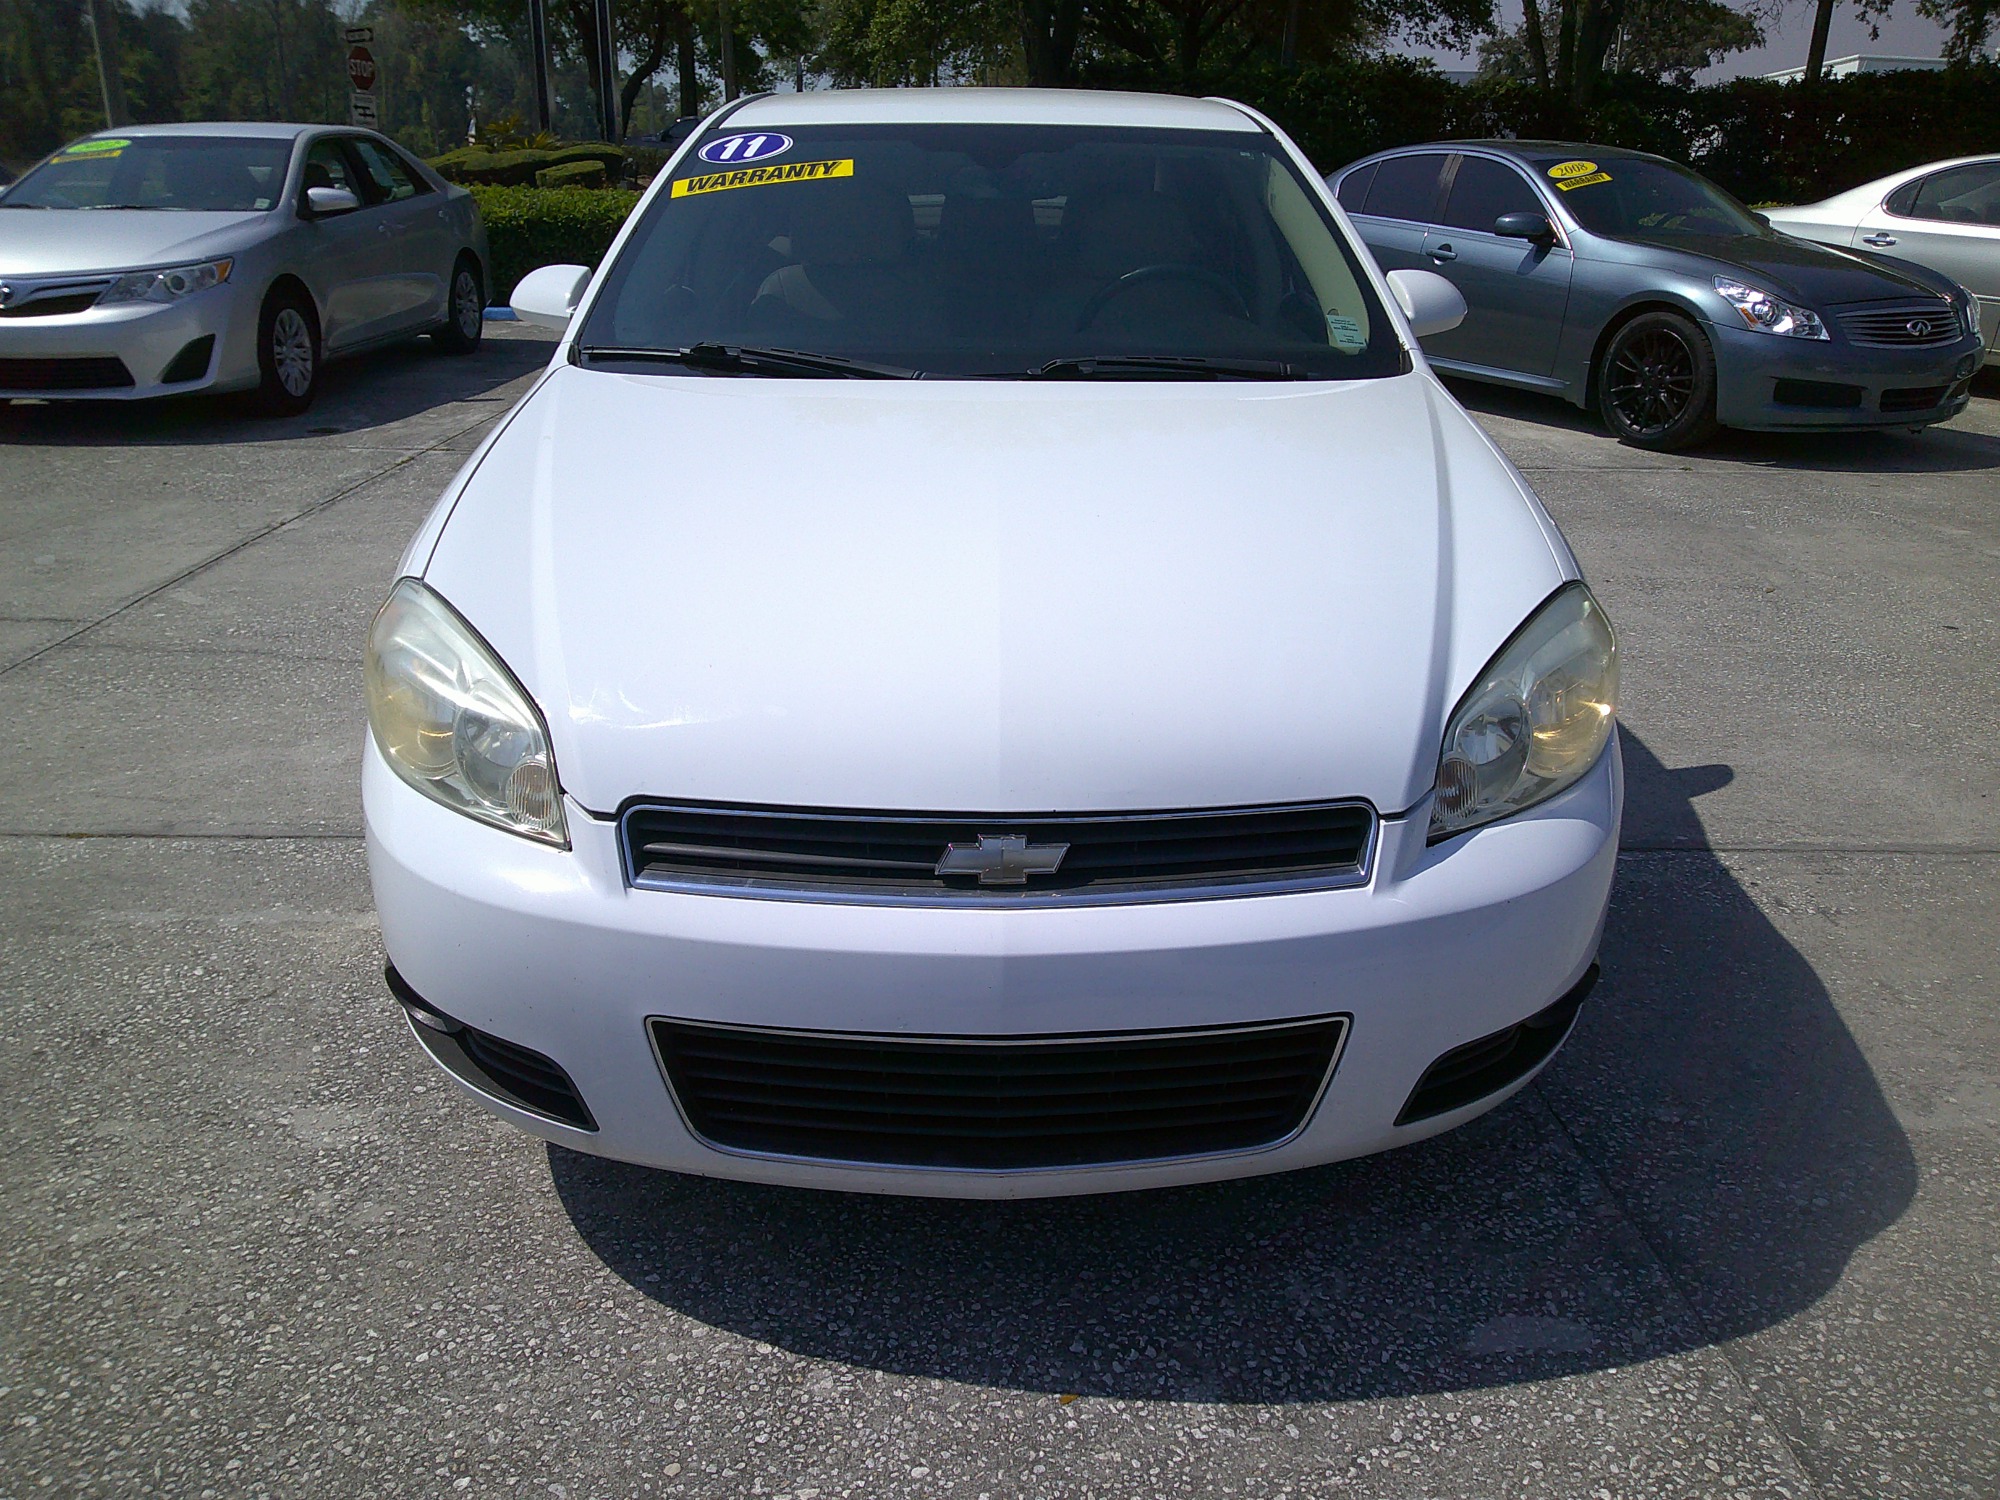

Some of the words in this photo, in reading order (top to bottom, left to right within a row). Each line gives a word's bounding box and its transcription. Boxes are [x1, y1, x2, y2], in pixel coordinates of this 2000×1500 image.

[349, 59, 374, 78] STOP
[720, 135, 768, 159] 11
[686, 161, 843, 193] WARRANTY
[1556, 162, 1588, 176] 2008
[1561, 173, 1606, 188] WARRANTY
